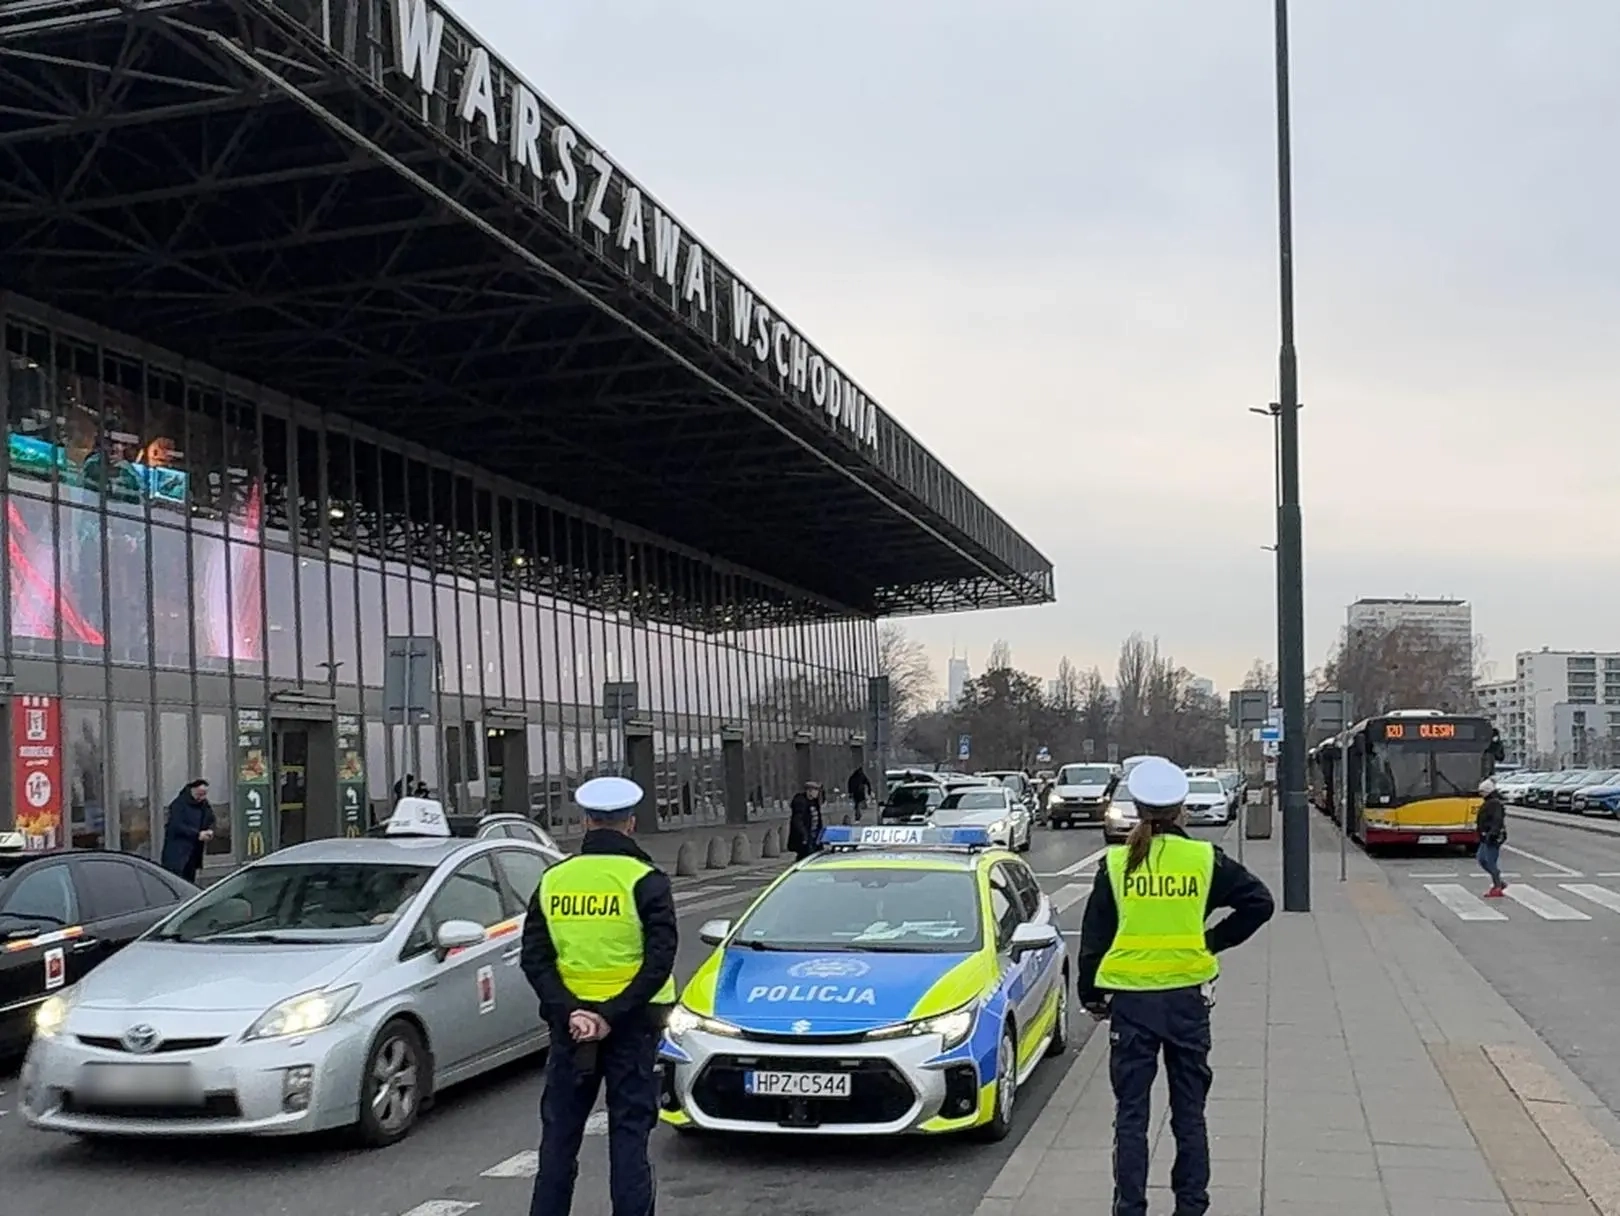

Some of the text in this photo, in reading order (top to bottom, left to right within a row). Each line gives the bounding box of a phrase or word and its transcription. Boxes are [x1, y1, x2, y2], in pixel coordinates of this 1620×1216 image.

[397, 0, 878, 450] WARSZAWA WSCHODNIA
[864, 829, 918, 843] POLICJA
[1123, 875, 1199, 897] POLICJA
[550, 895, 621, 916] POLICJA
[747, 985, 877, 1006] POLICJA
[757, 1073, 846, 1095] HPZ C544
